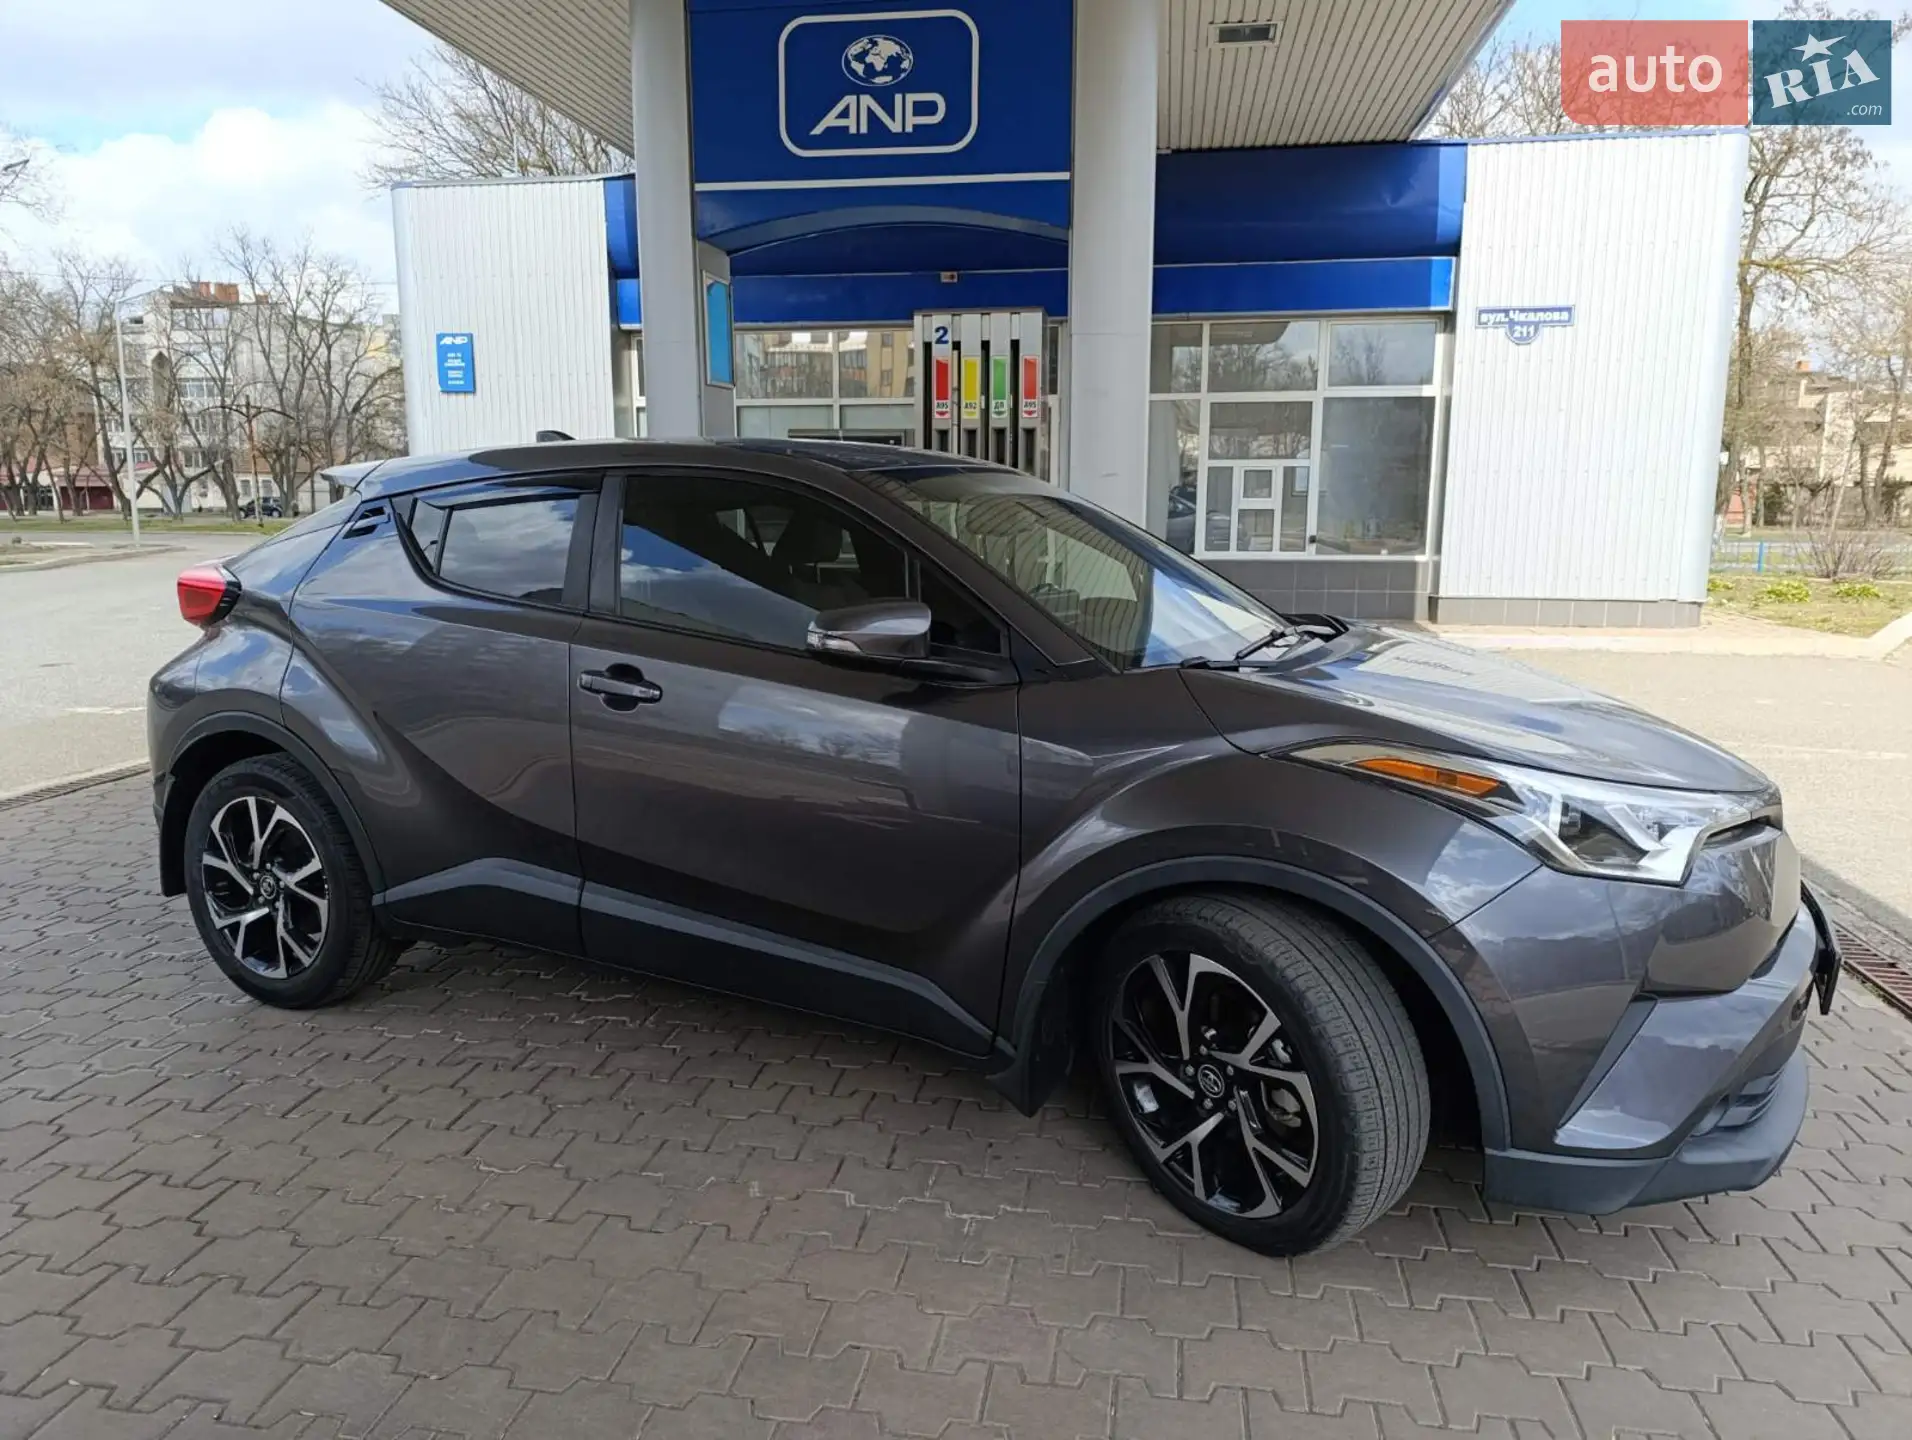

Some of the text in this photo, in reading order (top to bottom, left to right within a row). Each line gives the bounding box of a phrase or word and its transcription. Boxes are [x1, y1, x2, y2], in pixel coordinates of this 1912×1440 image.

[809, 92, 946, 135] ANP
[934, 326, 950, 345] 2
[1512, 325, 1535, 338] 211
[440, 336, 469, 345] ANP
